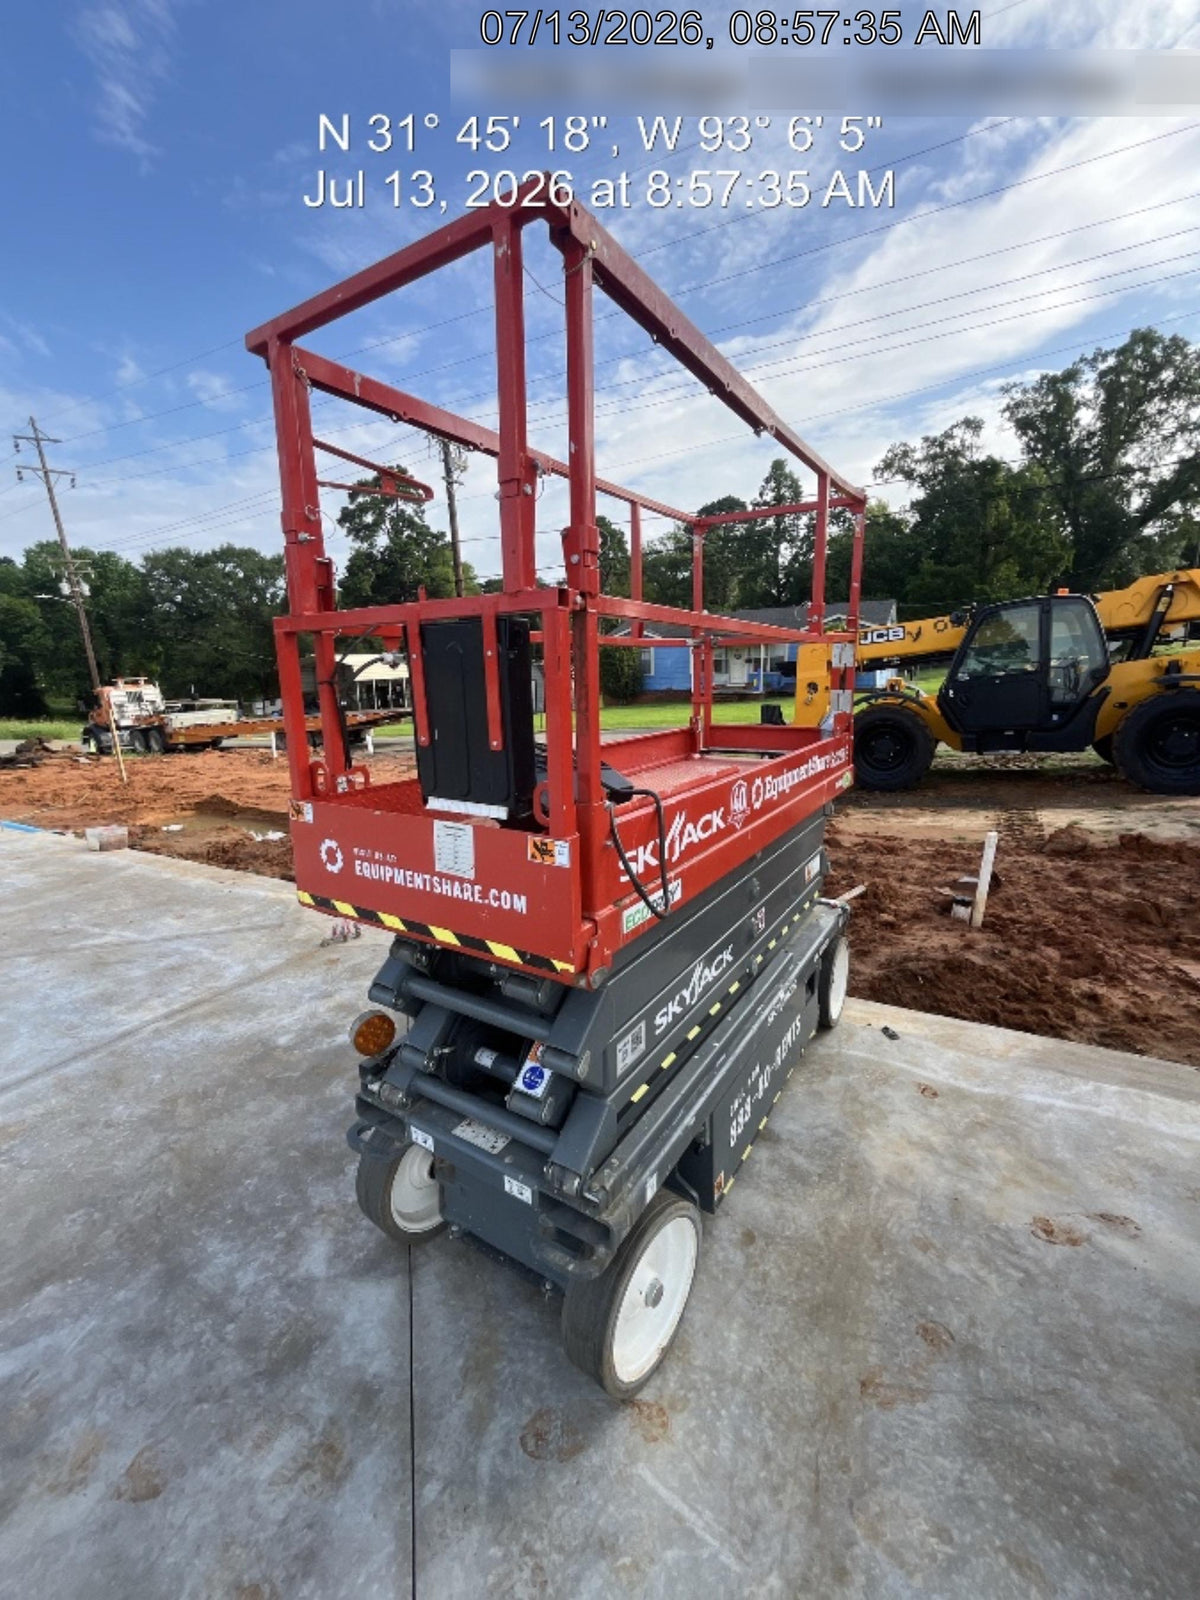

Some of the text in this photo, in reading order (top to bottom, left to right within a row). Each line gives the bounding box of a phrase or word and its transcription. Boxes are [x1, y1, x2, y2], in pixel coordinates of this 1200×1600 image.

[859, 627, 905, 645] JCB
[618, 806, 725, 883] SKYJACK
[354, 859, 528, 914] EQUIPMENTSHARE.COM
[654, 944, 734, 1036] SKYJACK
